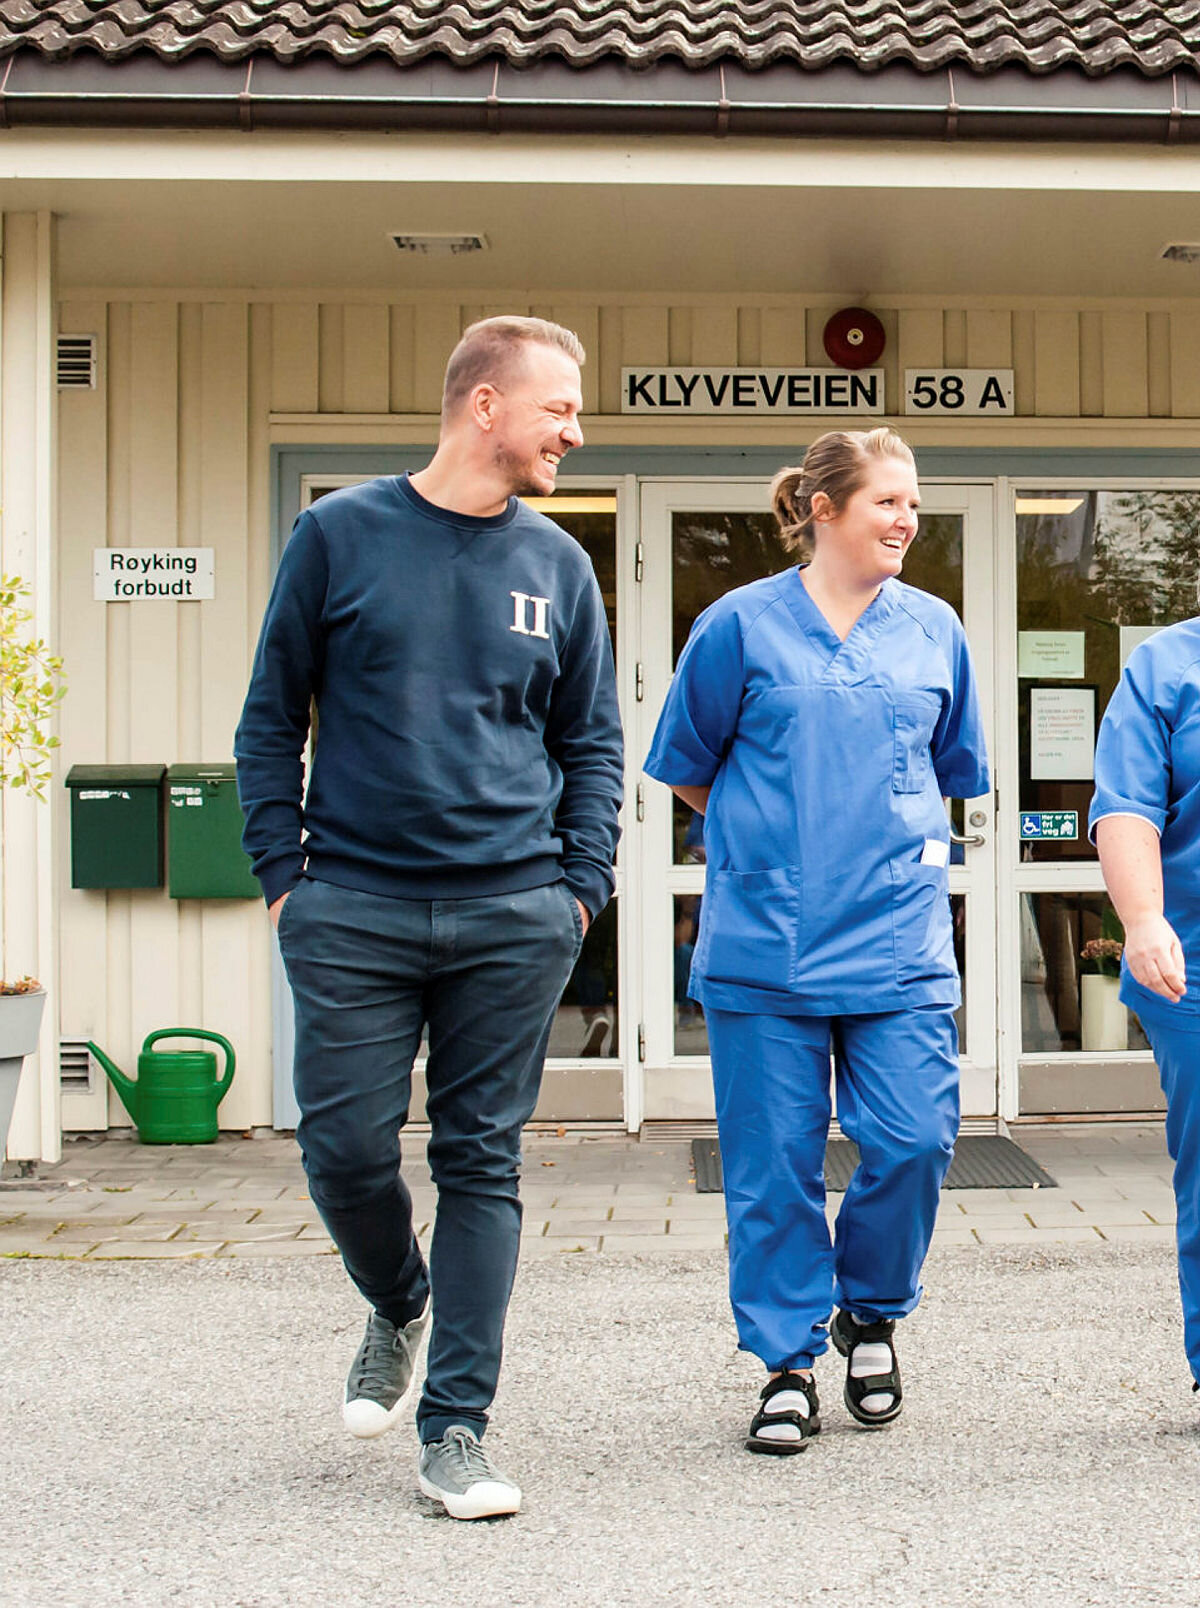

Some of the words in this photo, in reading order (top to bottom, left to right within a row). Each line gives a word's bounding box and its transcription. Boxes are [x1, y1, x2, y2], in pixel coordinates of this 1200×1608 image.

[628, 374, 877, 407] KLYVEVEIEN
[912, 376, 965, 408] 58
[978, 376, 1007, 408] A
[110, 553, 197, 574] Røyking
[114, 578, 192, 596] forbudt
[510, 591, 551, 639] II
